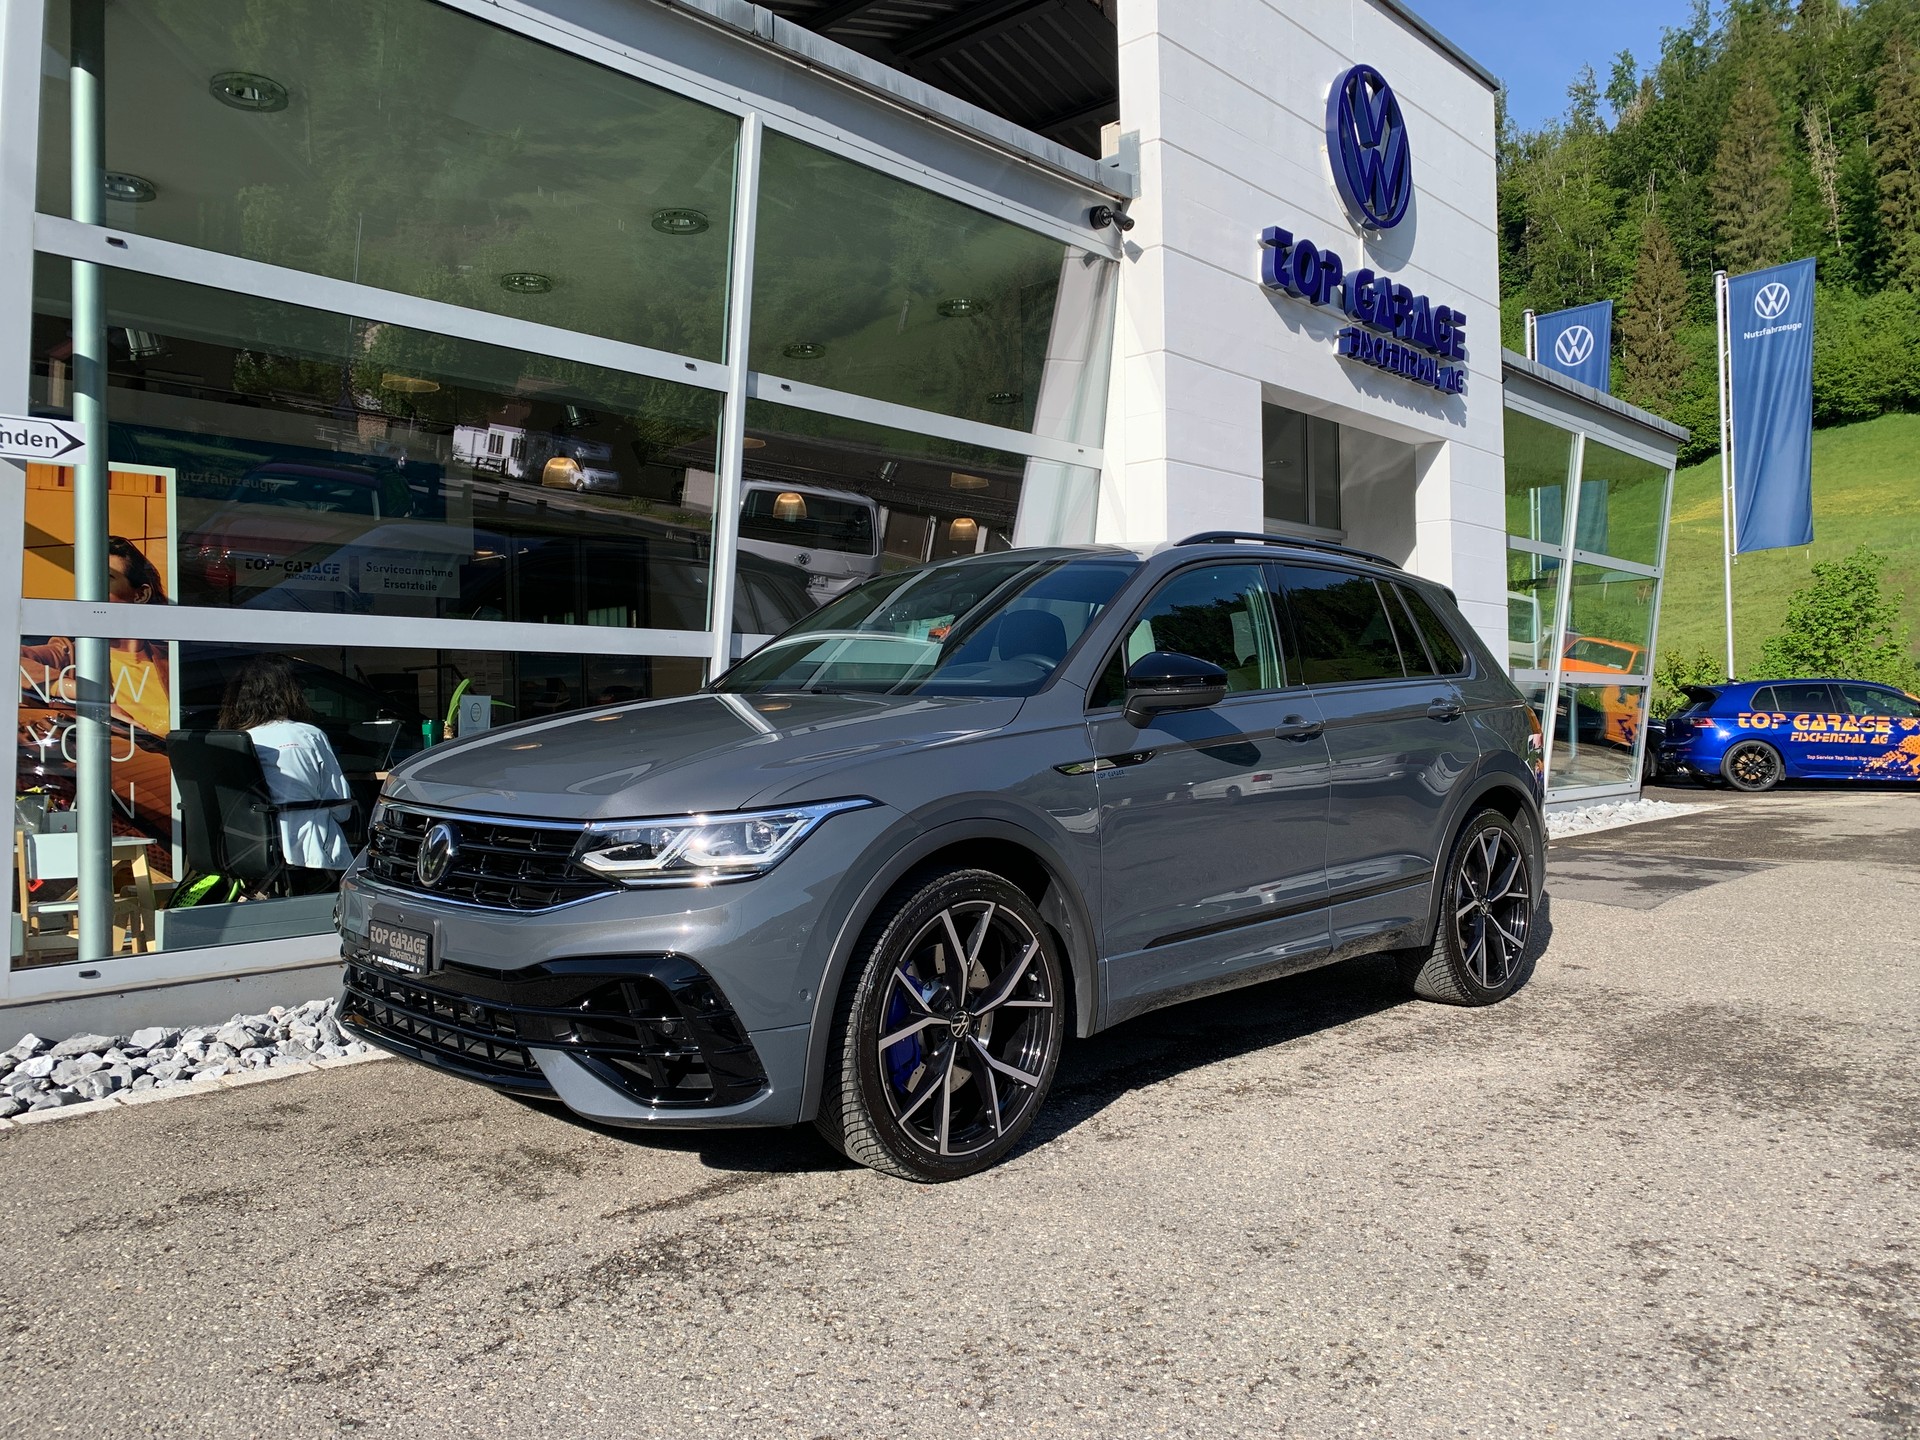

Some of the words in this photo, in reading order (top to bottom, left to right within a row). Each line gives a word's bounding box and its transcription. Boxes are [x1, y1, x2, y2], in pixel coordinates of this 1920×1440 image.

[1262, 226, 1343, 306] TOP
[1343, 268, 1467, 362] GARAGE
[1743, 322, 1803, 340] Nutzfahrzeuge
[176, 467, 280, 493] utzfahrzeuge
[366, 561, 453, 578] Serviceannahme
[383, 578, 438, 592] Ersatzteile
[1738, 712, 1787, 729] TOP
[1793, 713, 1891, 733] GARAGE
[1870, 734, 1889, 745] AG
[370, 925, 389, 945] TOP
[389, 931, 426, 956] GARAGE
